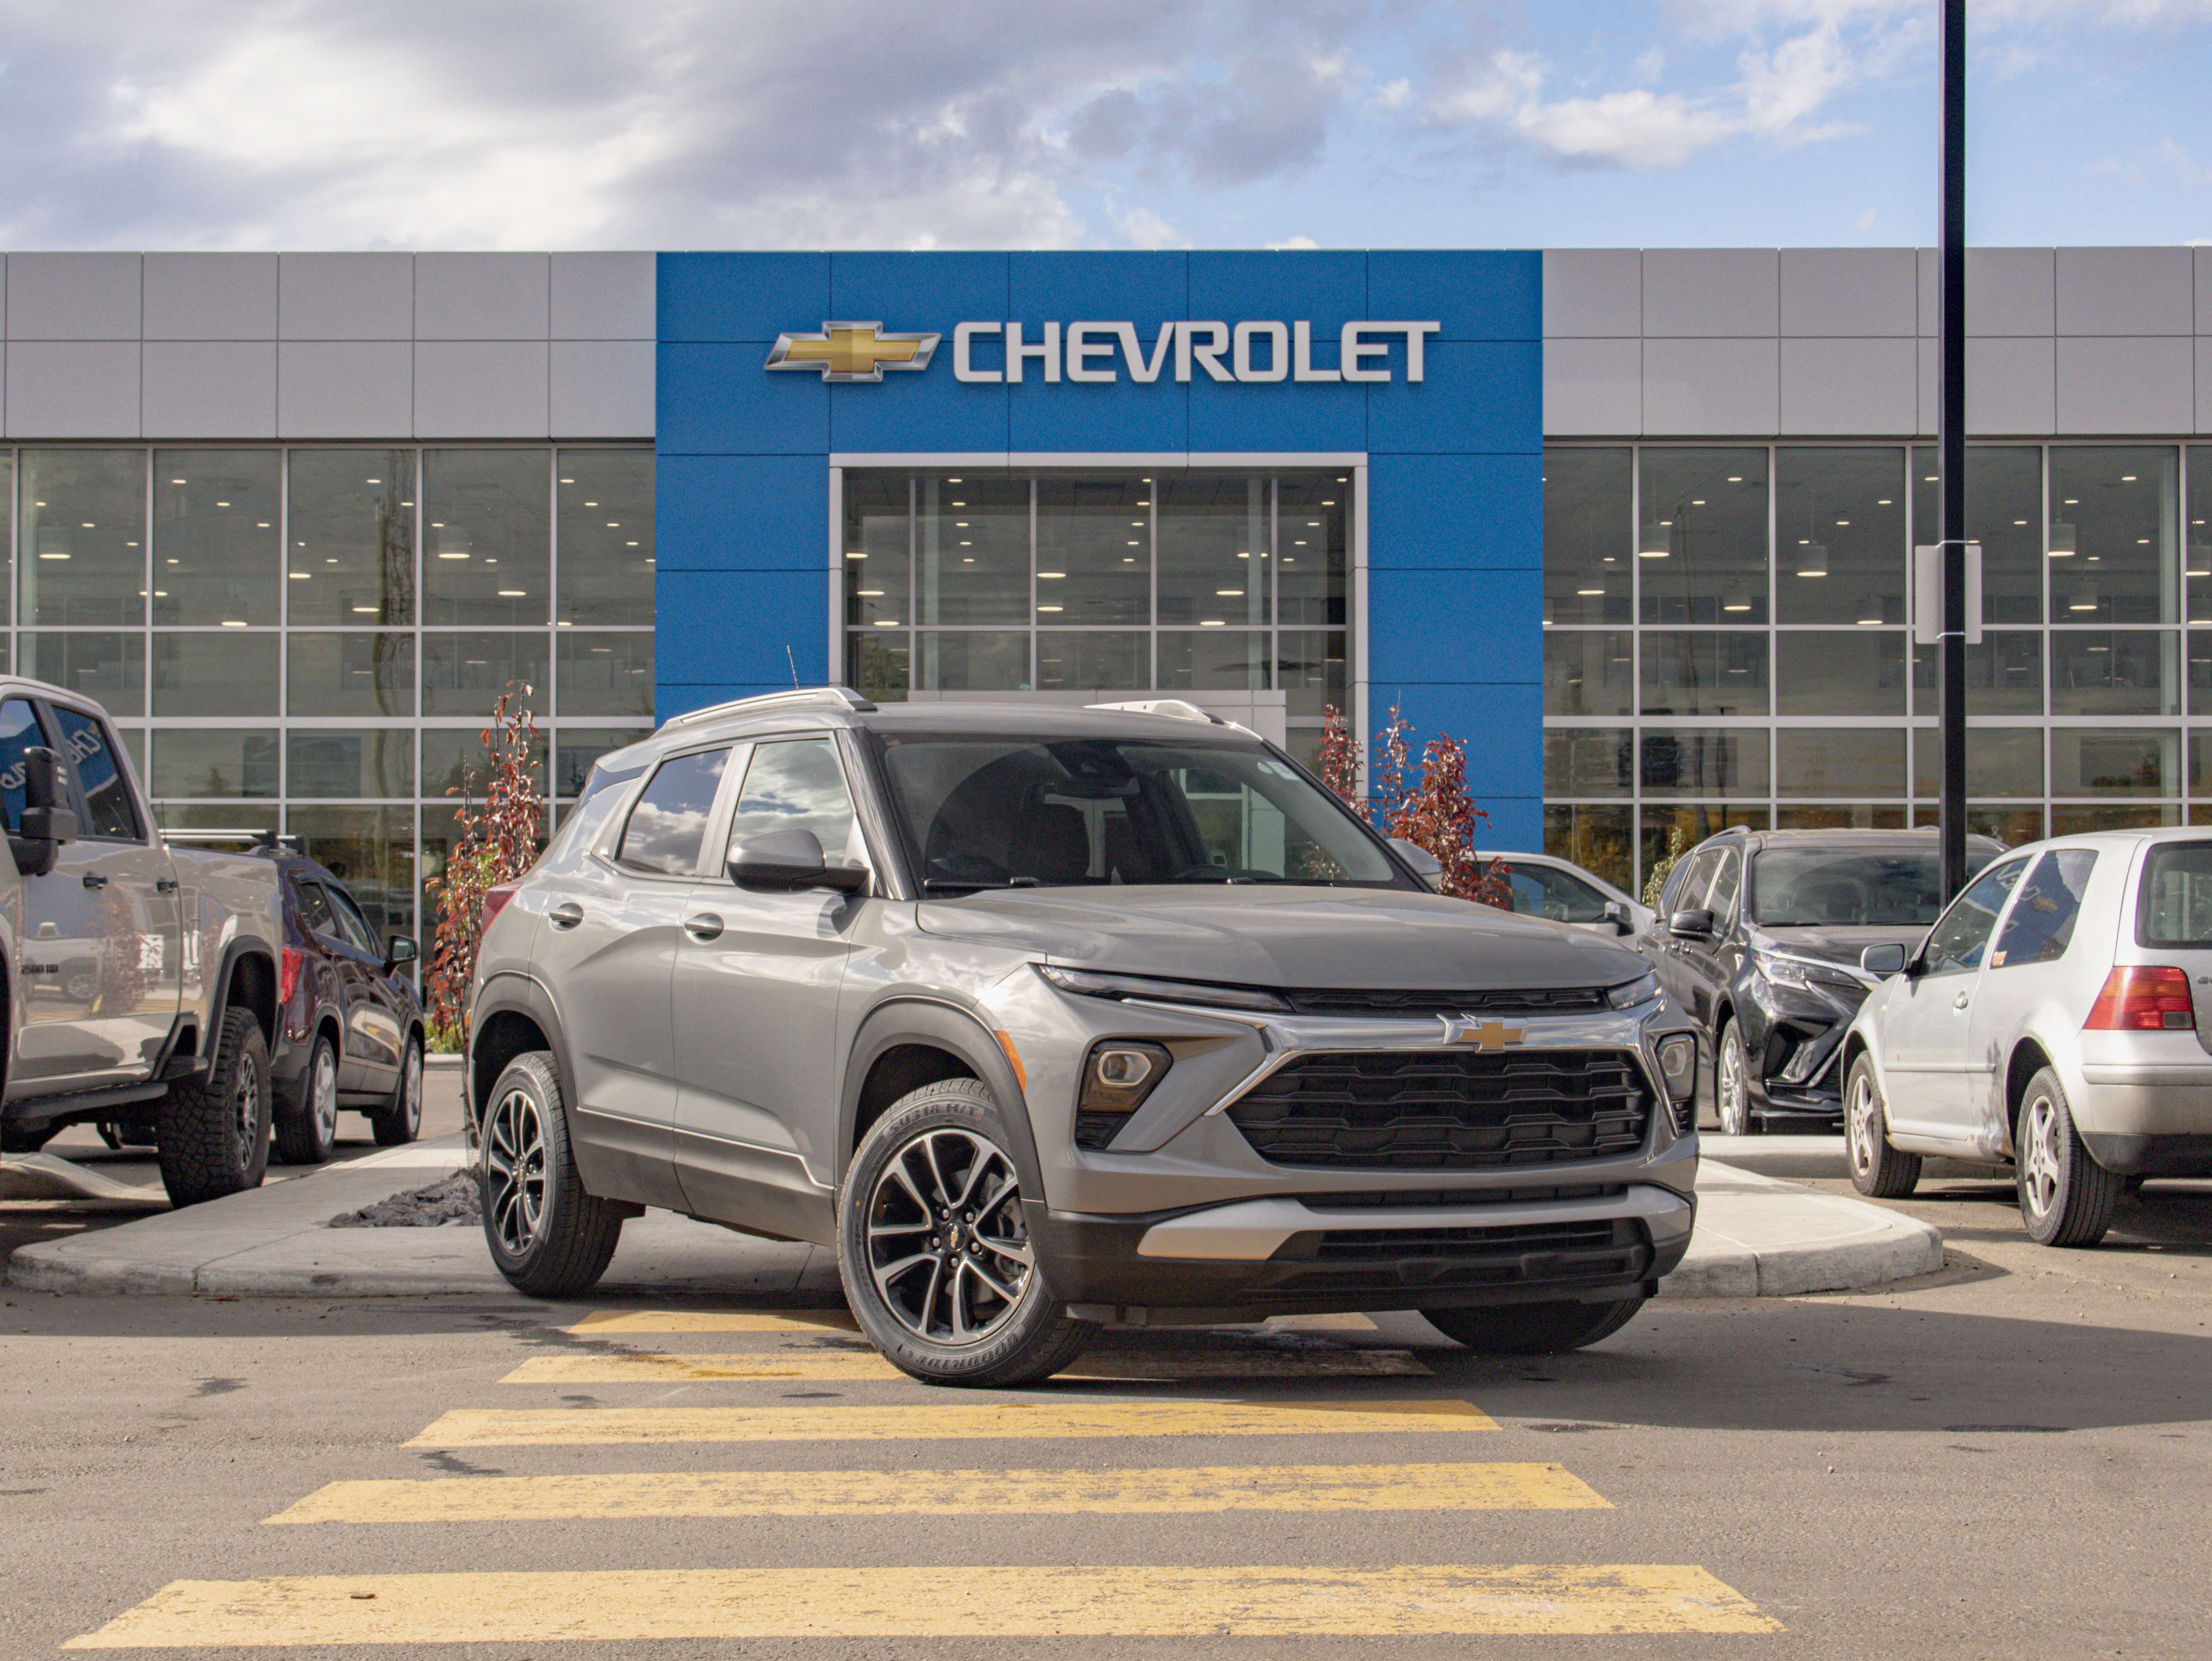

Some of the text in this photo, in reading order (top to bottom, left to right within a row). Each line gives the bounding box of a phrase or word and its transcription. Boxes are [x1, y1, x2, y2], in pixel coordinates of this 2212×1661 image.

[953, 321, 1441, 383] CHEVROLET
[889, 1104, 940, 1136] SU318
[946, 1102, 979, 1116] H/T
[916, 1333, 1017, 1370] GOODRIDE
